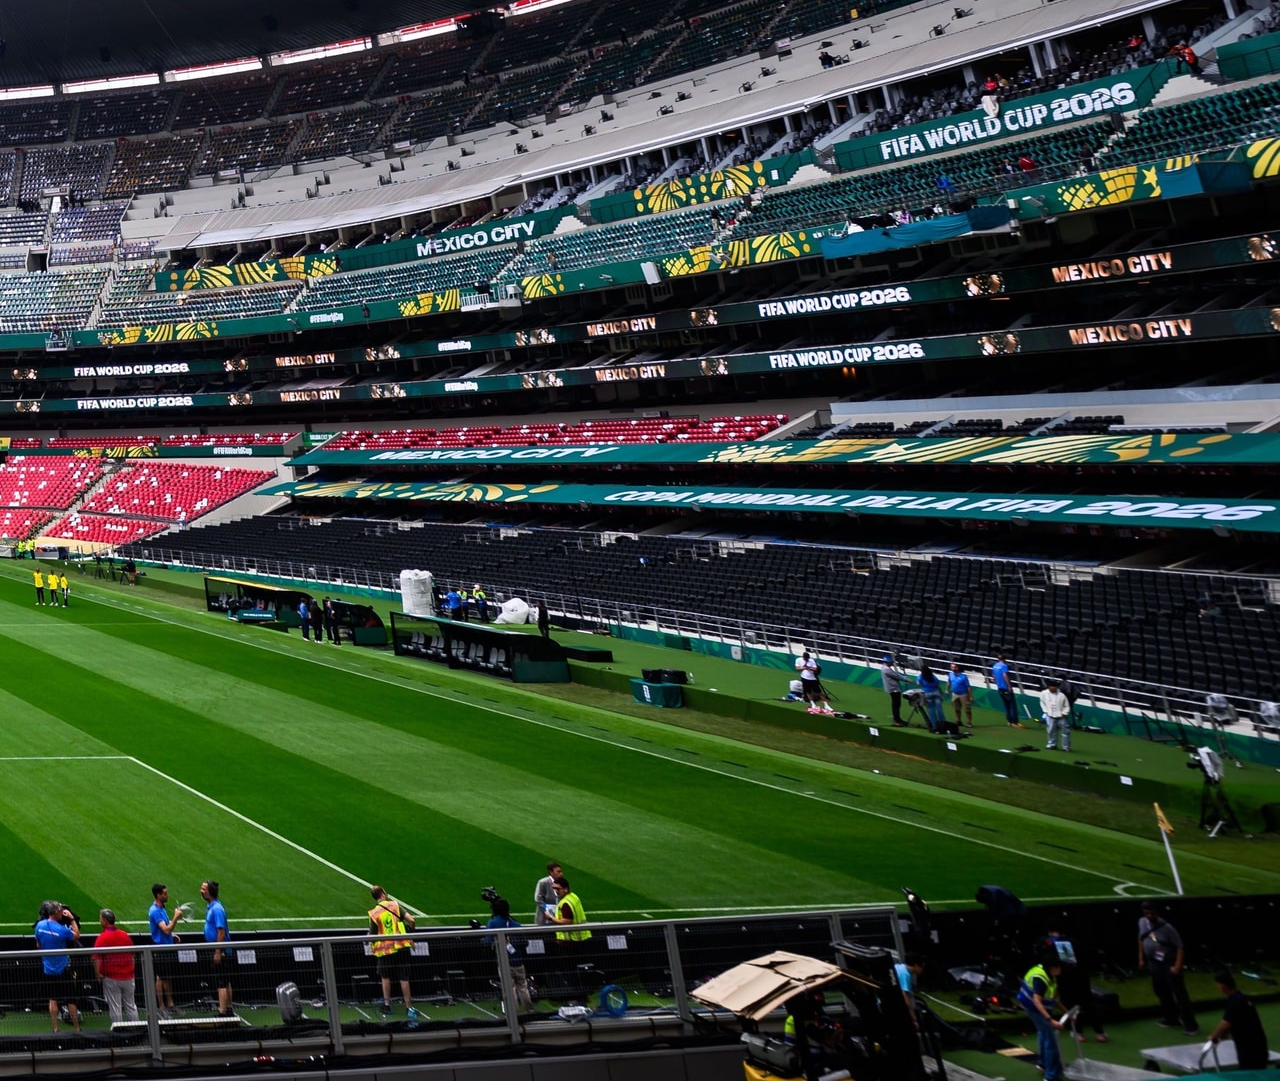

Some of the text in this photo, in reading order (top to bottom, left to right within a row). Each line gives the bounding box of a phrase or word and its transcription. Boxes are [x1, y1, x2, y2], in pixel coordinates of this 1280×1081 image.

[880, 82, 1136, 160] FIFA WORLD CUP 2026
[416, 220, 535, 258] MEXICO CITY
[1052, 252, 1172, 282] MEXICO CITY
[758, 287, 910, 317] FIFA WORLD CUP 2026
[587, 317, 656, 336] MEXICO CITY
[1068, 318, 1192, 345] MEXICO CITY
[275, 353, 335, 367] MEXICO CITY
[769, 342, 924, 369] FIFA WORLD CUP 2026
[74, 363, 189, 377] FIFA WORLD CUP 2026
[595, 365, 666, 382] MEXICO CITY
[77, 397, 193, 410] FIFA WORLD CUP 2026
[280, 389, 341, 402] MEXICO CITY
[369, 447, 621, 460] MEXICO CITY
[604, 491, 1277, 521] COPA MUNDIAL DE LA FIFA 2026
